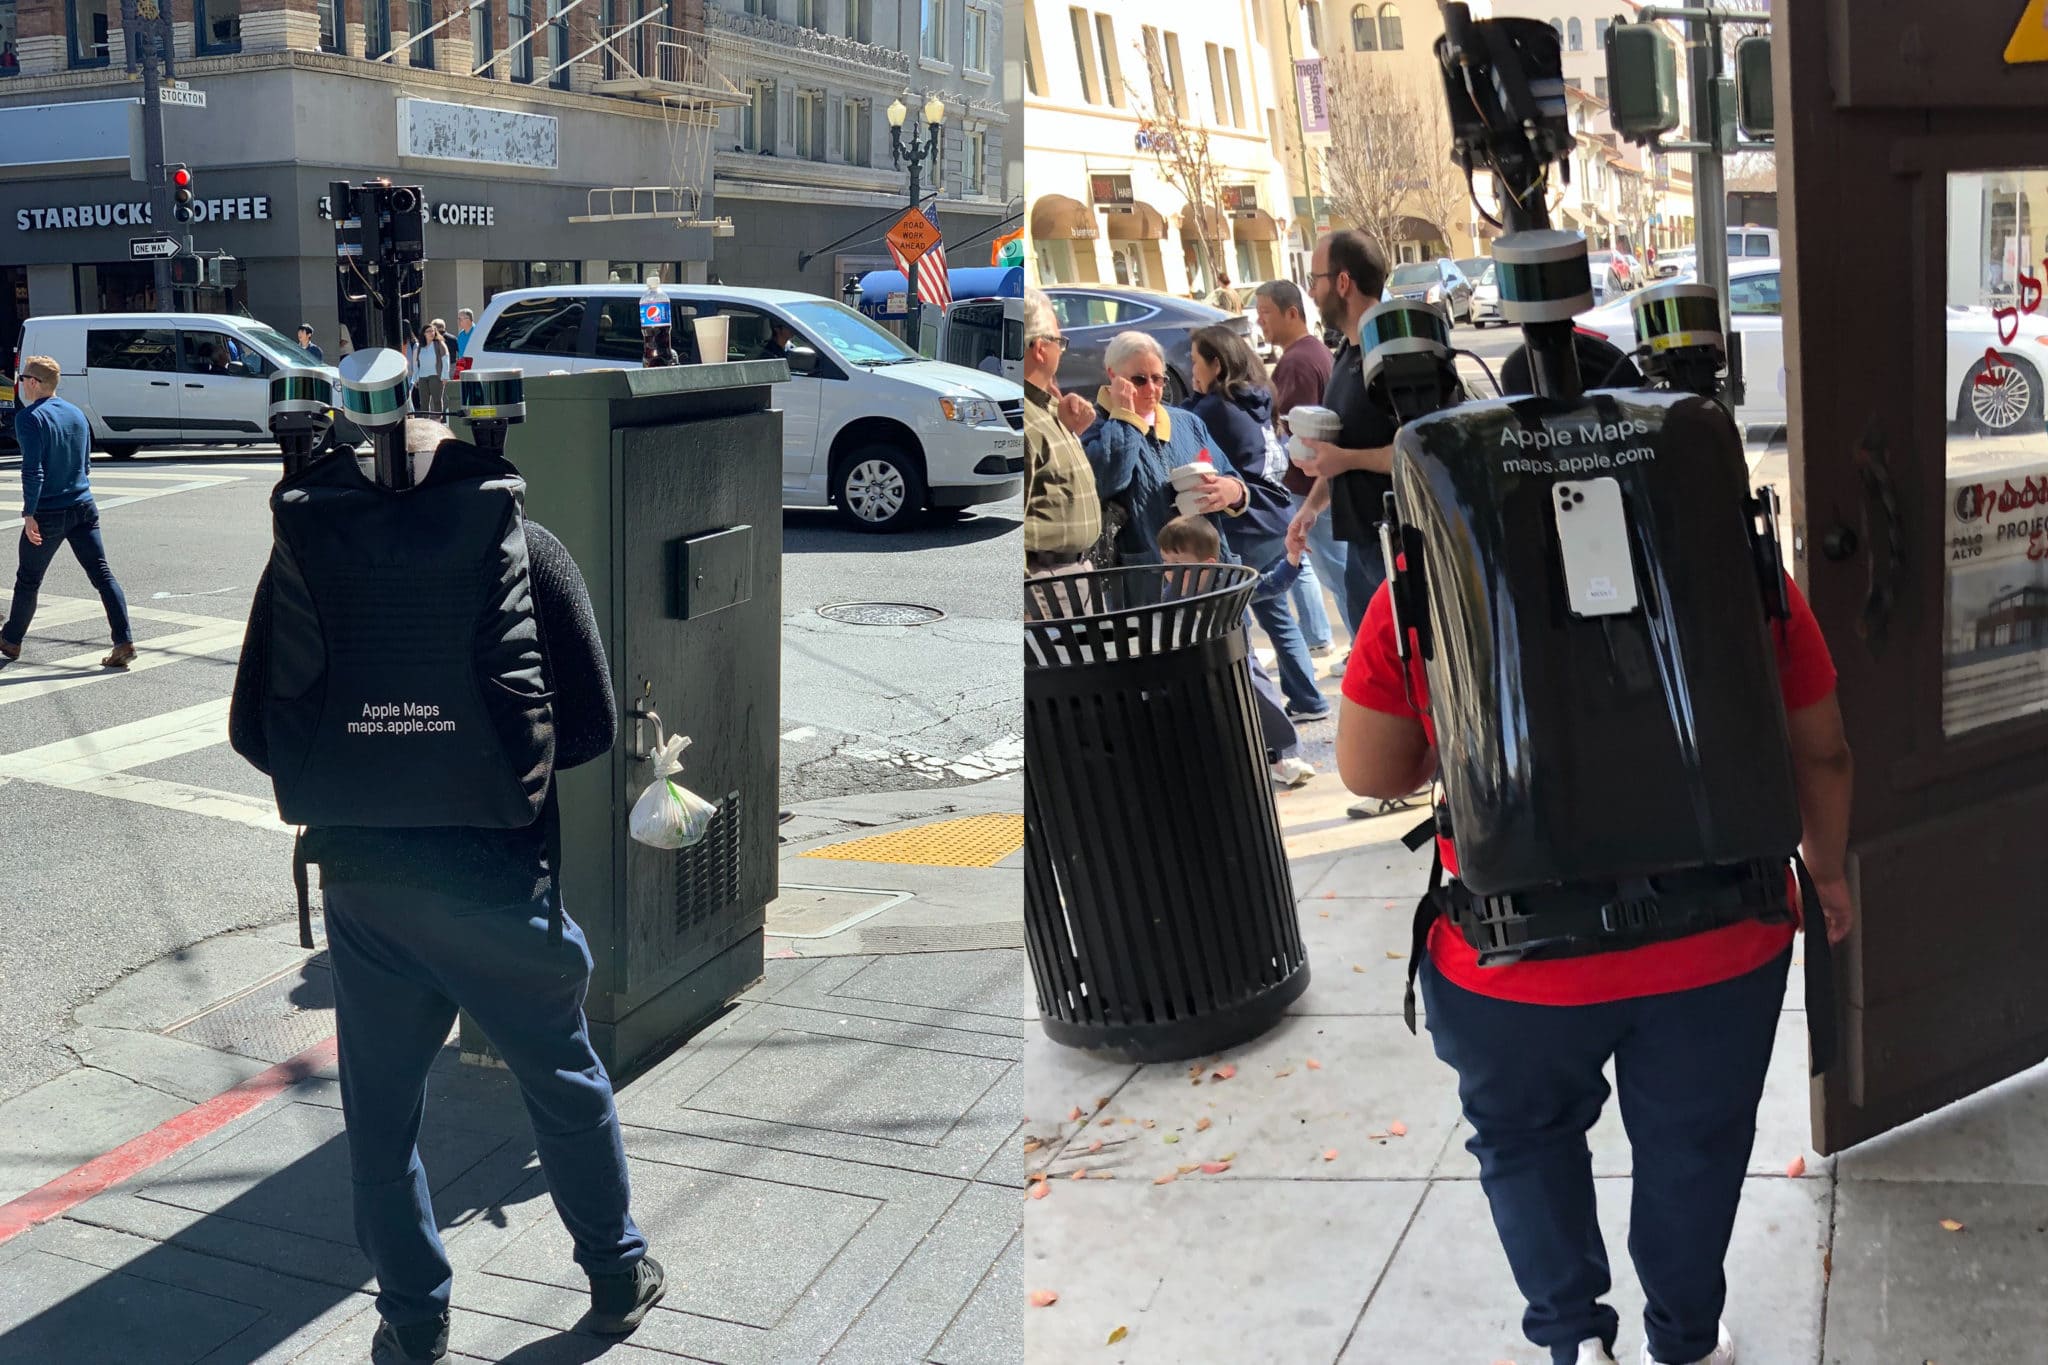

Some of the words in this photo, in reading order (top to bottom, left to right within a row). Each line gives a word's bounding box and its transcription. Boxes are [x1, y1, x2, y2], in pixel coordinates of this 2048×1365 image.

[1296, 60, 1323, 77] meet
[161, 90, 204, 105] STOCKTON
[1309, 75, 1325, 120] street
[174, 197, 268, 222] OFFEE
[438, 203, 495, 227] COFFEE
[903, 221, 925, 230] ROAD
[902, 232, 924, 240] WORK
[135, 244, 149, 254] ONE
[151, 243, 167, 253] WAY
[900, 242, 926, 250] AHEAD
[1500, 425, 1573, 450] Apple
[1578, 419, 1649, 445] Maps
[1502, 447, 1656, 475] maps.apple.com
[1953, 533, 1983, 547] PALO
[1952, 546, 1983, 560] ALTO
[362, 702, 400, 720] Apple
[403, 702, 440, 719] Maps
[347, 719, 456, 736] maps.apple.com
